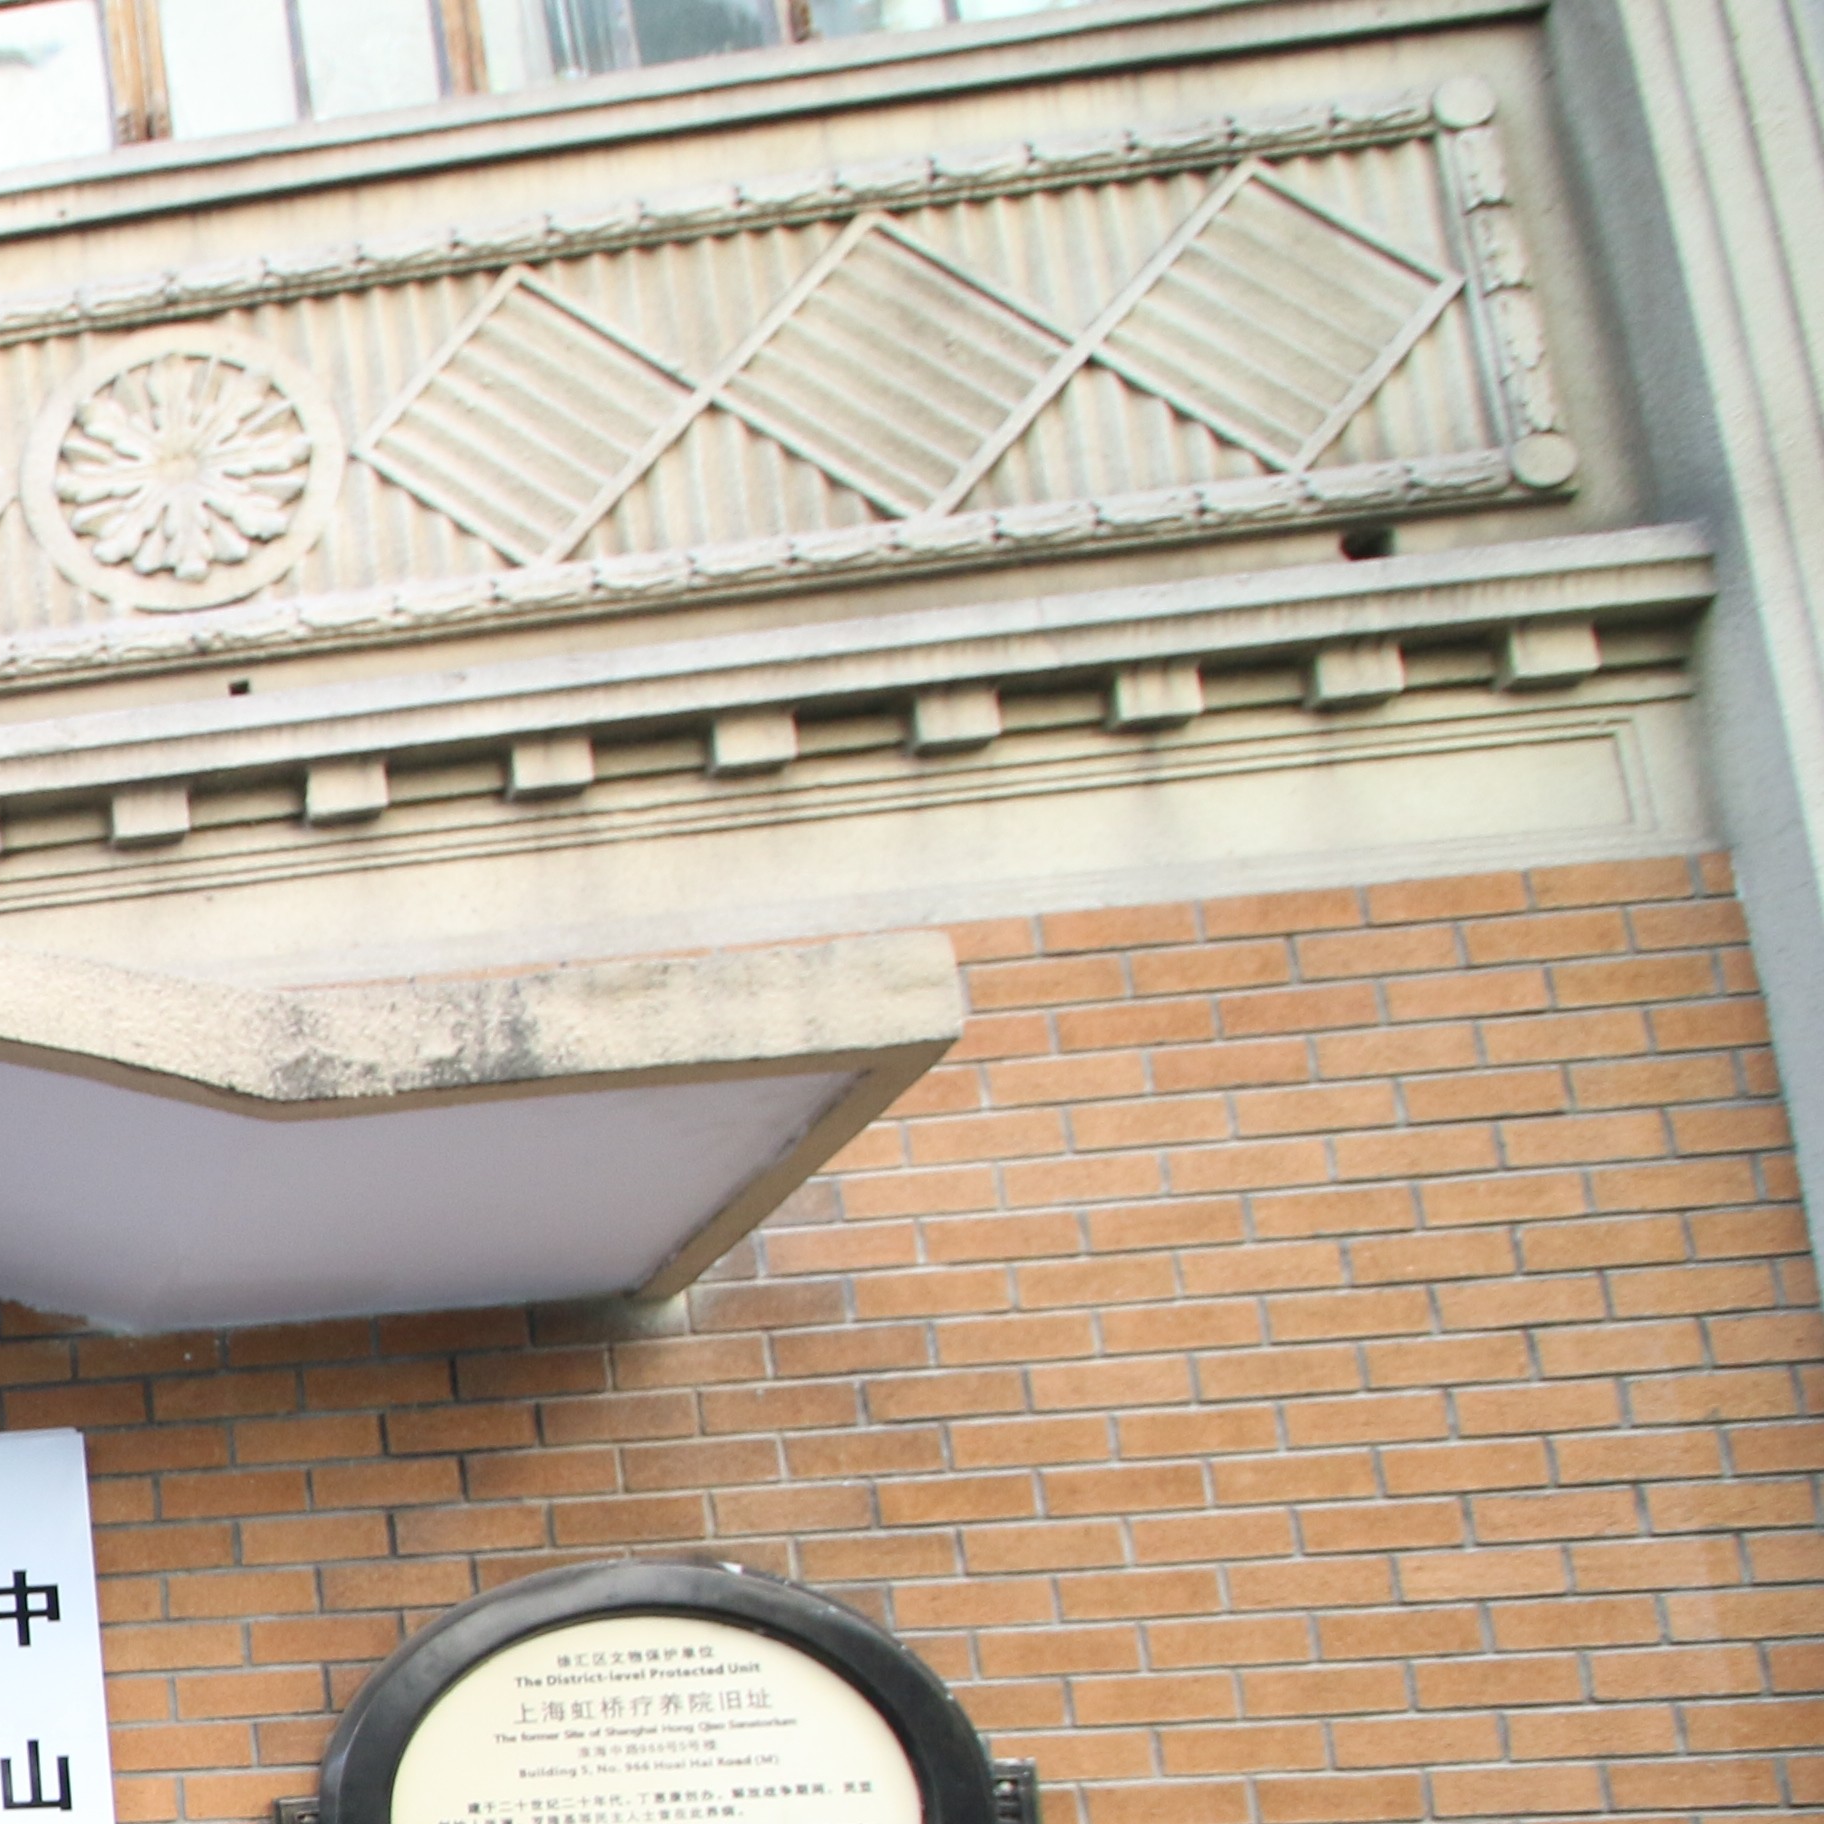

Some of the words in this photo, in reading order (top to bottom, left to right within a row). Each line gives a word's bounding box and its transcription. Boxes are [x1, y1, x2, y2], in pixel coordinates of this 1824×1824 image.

[557, 1646, 713, 1668] 徐汇区文物保护单位
[515, 1676, 542, 1688] The
[546, 1669, 645, 1686] District-level
[650, 1665, 724, 1679] Protected
[728, 1663, 760, 1674] Unit
[513, 1686, 771, 1725] 上海虹桥疗养院旧址
[495, 1733, 517, 1744] The
[521, 1732, 559, 1742] former
[589, 1728, 601, 1737] of
[604, 1723, 658, 1738] Shanghai
[662, 1723, 694, 1733] Hong
[519, 1766, 577, 1779] Building
[597, 1764, 621, 1774] No.
[625, 1762, 649, 1772] 966
[654, 1759, 686, 1769] Huai
[690, 1758, 713, 1768] Hai
[717, 1755, 751, 1766] Road
[755, 1753, 779, 1766] (M)
